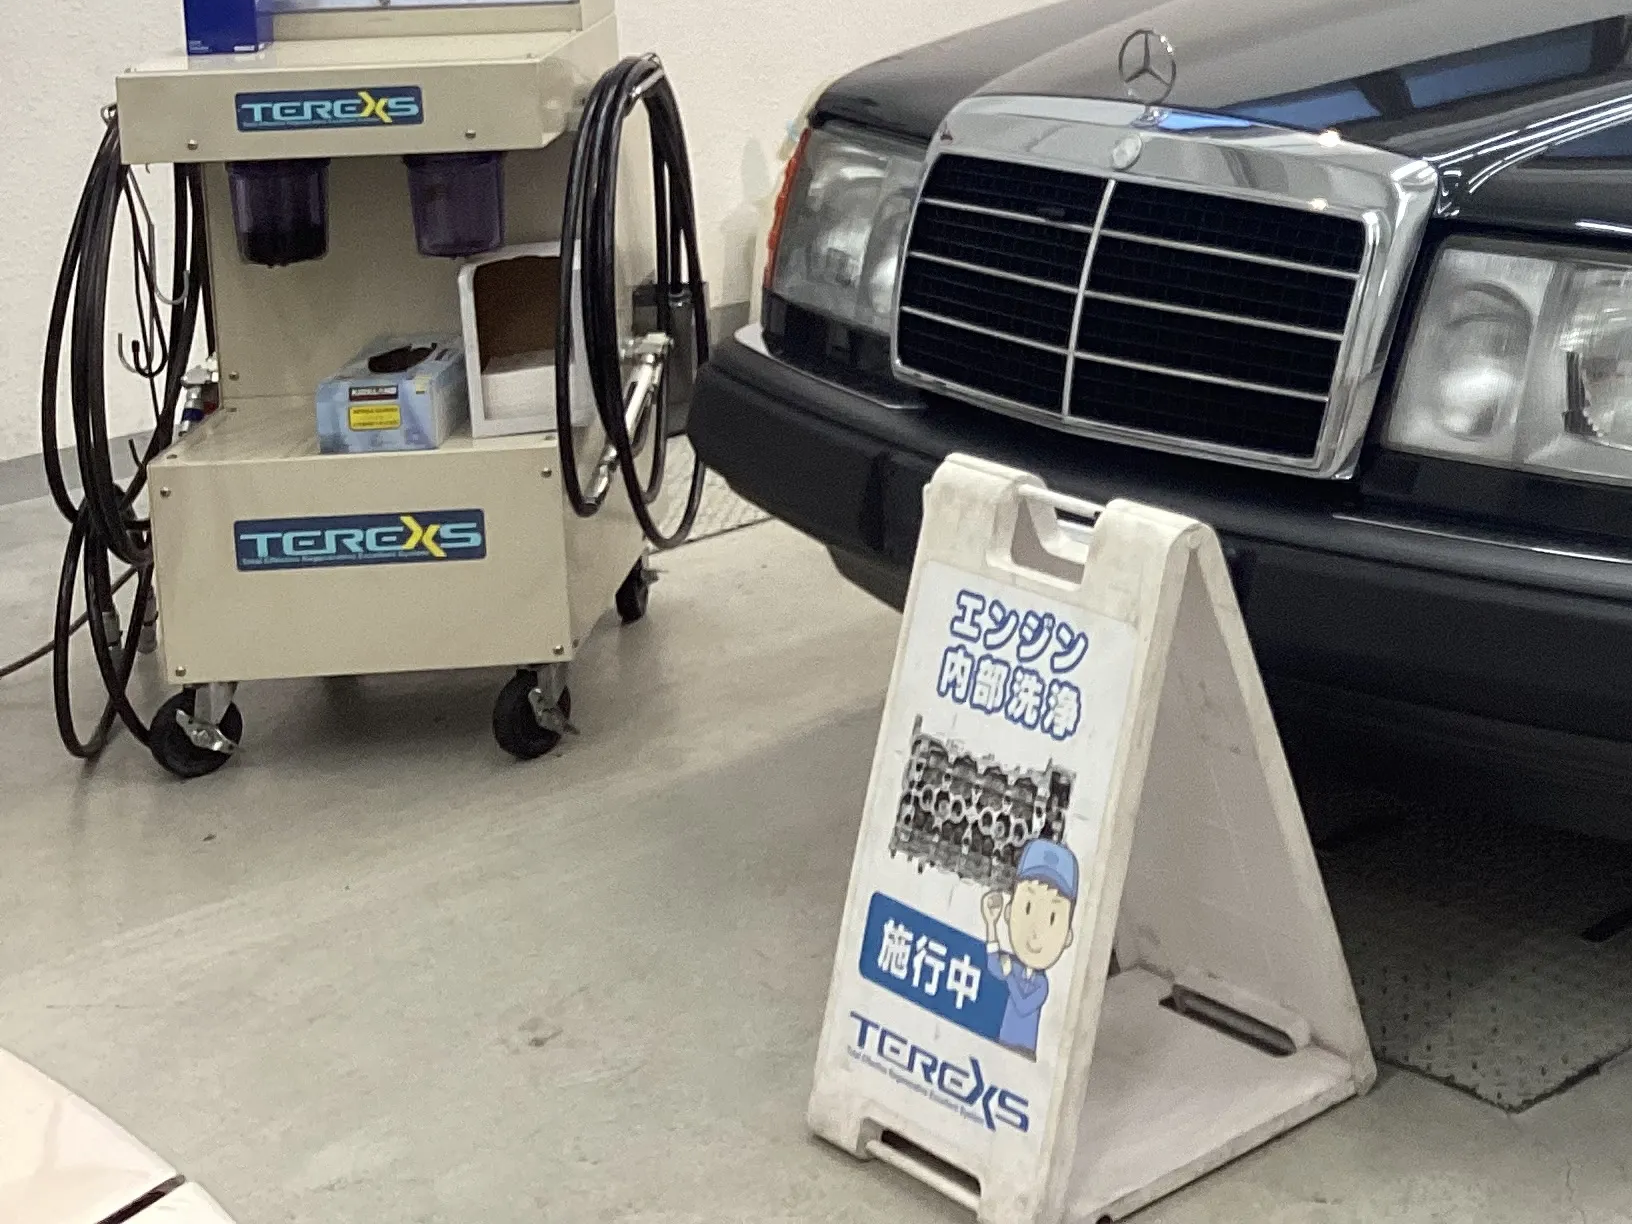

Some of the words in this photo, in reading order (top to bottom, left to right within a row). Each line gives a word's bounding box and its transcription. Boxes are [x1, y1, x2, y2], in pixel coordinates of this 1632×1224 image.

[241, 91, 419, 123] TEREXS
[240, 515, 482, 558] TEREXS
[950, 589, 1089, 673] エンジン
[937, 644, 1081, 741] 内部洗浄
[877, 916, 982, 1011] 施行中
[850, 1010, 1030, 1133] TEREXS
